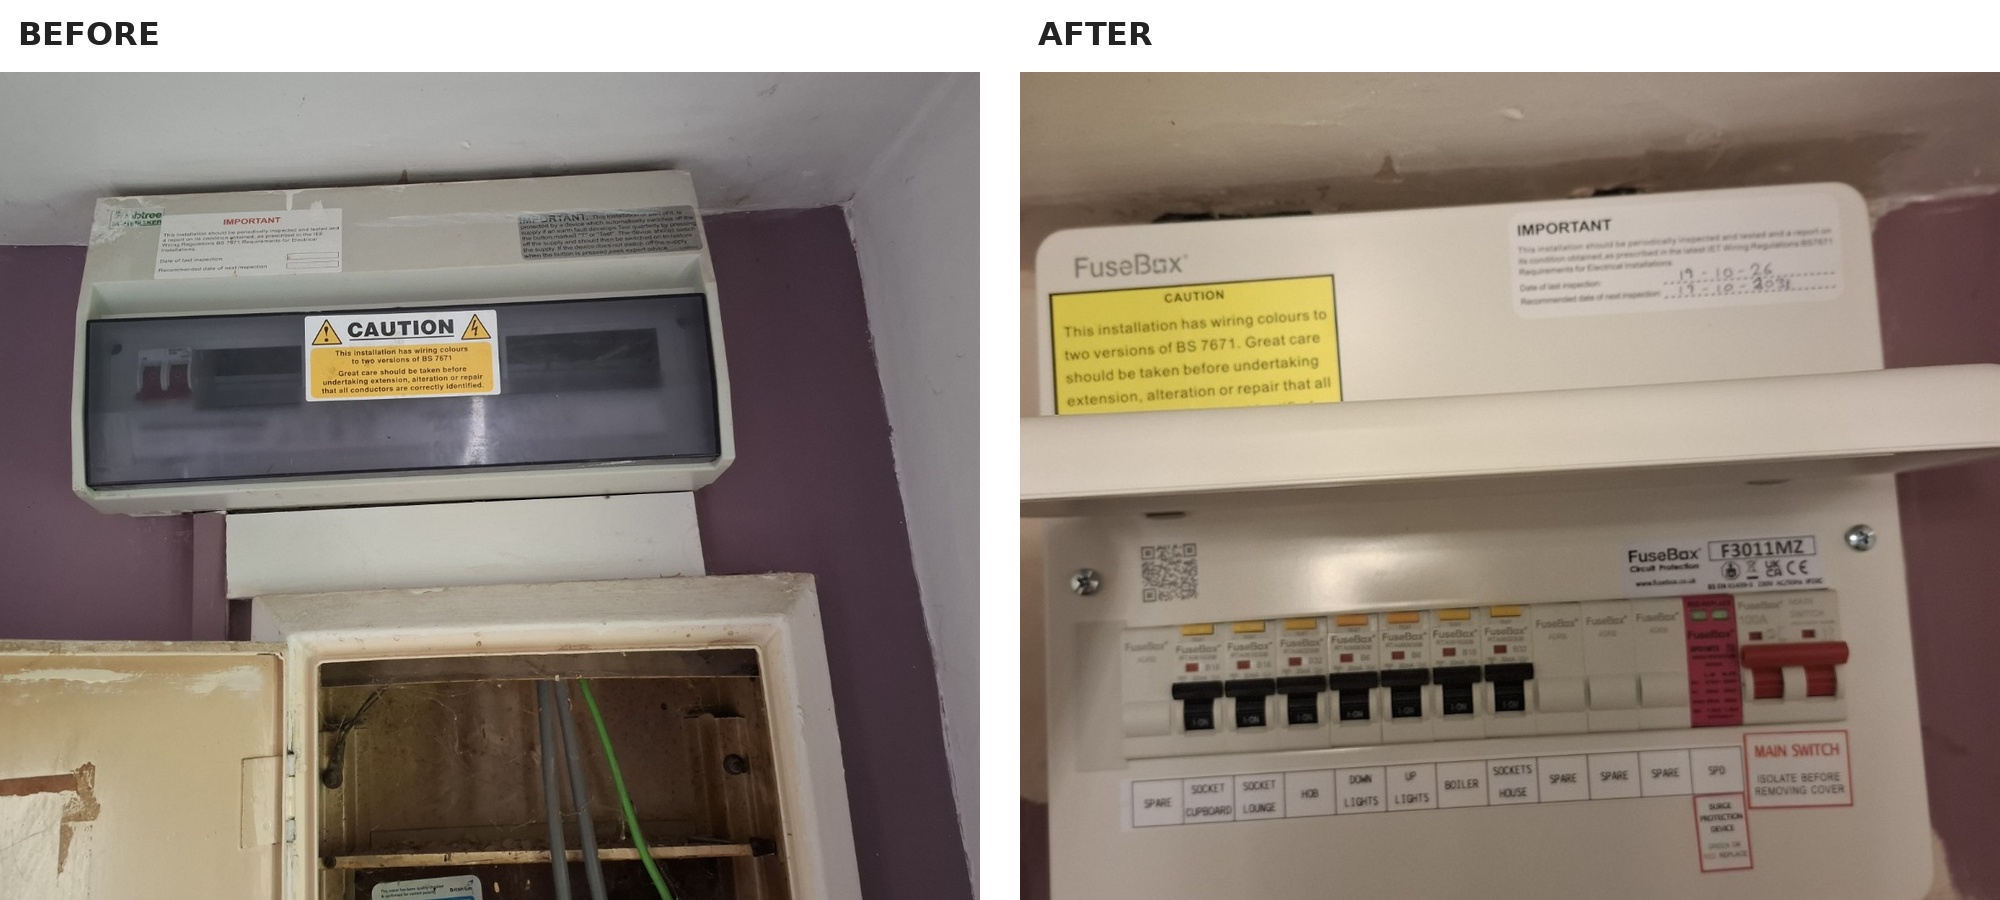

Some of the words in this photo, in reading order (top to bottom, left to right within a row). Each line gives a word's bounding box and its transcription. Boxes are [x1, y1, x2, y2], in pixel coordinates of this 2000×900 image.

[223, 216, 281, 226] IMPORTANT
[1517, 219, 1612, 236] IMPORTANT
[1074, 254, 1182, 278] FuseBox
[1164, 289, 1225, 303] CAUTION
[347, 319, 454, 338] CAUTION
[1064, 324, 1094, 338] This
[1097, 319, 1177, 336] installation
[1180, 317, 1207, 330] has
[1209, 314, 1253, 329] wiring
[1256, 310, 1310, 325] colours
[1312, 309, 1327, 321] to
[353, 348, 396, 356] installation
[413, 347, 437, 355] wiring
[1064, 348, 1090, 361] two
[1092, 344, 1155, 359] versions
[1157, 343, 1172, 355] of
[1174, 341, 1197, 354] BS
[1200, 338, 1241, 352] 7671.
[1243, 335, 1286, 349] Great
[1288, 335, 1321, 346] care
[376, 356, 410, 364] versions
[1066, 370, 1114, 384] should
[1116, 368, 1136, 380] be
[1138, 365, 1179, 379] taken
[1182, 362, 1230, 376] before
[1232, 356, 1319, 372] undertaking
[322, 378, 368, 386] undertaking
[369, 376, 410, 384] extension,
[460, 374, 483, 382] repair
[349, 385, 394, 393] conductors
[409, 383, 444, 392] correctly
[445, 382, 484, 390] identified.
[1067, 390, 1142, 406] extension,
[1145, 385, 1215, 401] alteration
[1236, 380, 1279, 395] repair
[1282, 378, 1311, 391] that
[1313, 376, 1331, 389] all
[1721, 539, 1804, 558] F3011MZ
[1628, 548, 1698, 562] FuseBox
[1657, 563, 1699, 571] Protection
[1586, 616, 1625, 626] FuseBox
[1636, 612, 1676, 623] FuseBox
[1535, 618, 1575, 629] FuseBox
[1432, 629, 1474, 639] FuseBox
[1484, 626, 1524, 636] FuseBox
[1331, 634, 1372, 644] FuseBox
[1382, 632, 1424, 642] FuseBox
[1125, 641, 1165, 651] FuseBox
[1228, 642, 1269, 651] FuseBox
[1280, 638, 1320, 648] FuseBox
[1175, 644, 1218, 654] FuseBox
[1754, 744, 1789, 758] MAIN
[1790, 743, 1840, 757] SWITCH
[1493, 764, 1532, 776] SOCKETS
[1651, 767, 1680, 779] SPARE
[1708, 765, 1726, 776] SPD
[1349, 774, 1372, 785] DOWN
[1405, 771, 1416, 782] UP
[1550, 772, 1577, 784] SPARE
[1600, 770, 1629, 782] SPARE
[1756, 772, 1799, 783] ISOLATE
[1800, 772, 1841, 783] BEFORE
[1191, 783, 1224, 794] SOCKET
[1243, 779, 1276, 791] SOCKET
[1445, 778, 1479, 790] BOILER
[1499, 787, 1527, 798] HOUSE
[1755, 785, 1808, 796] REMOVING
[1809, 784, 1845, 795] COVER
[1144, 797, 1172, 808] SPARE
[1344, 796, 1379, 808] LIGHTS
[1394, 792, 1429, 804] LIGHTS
[1186, 804, 1232, 817] CUPBOARD
[1243, 802, 1276, 814] LOUNGE
